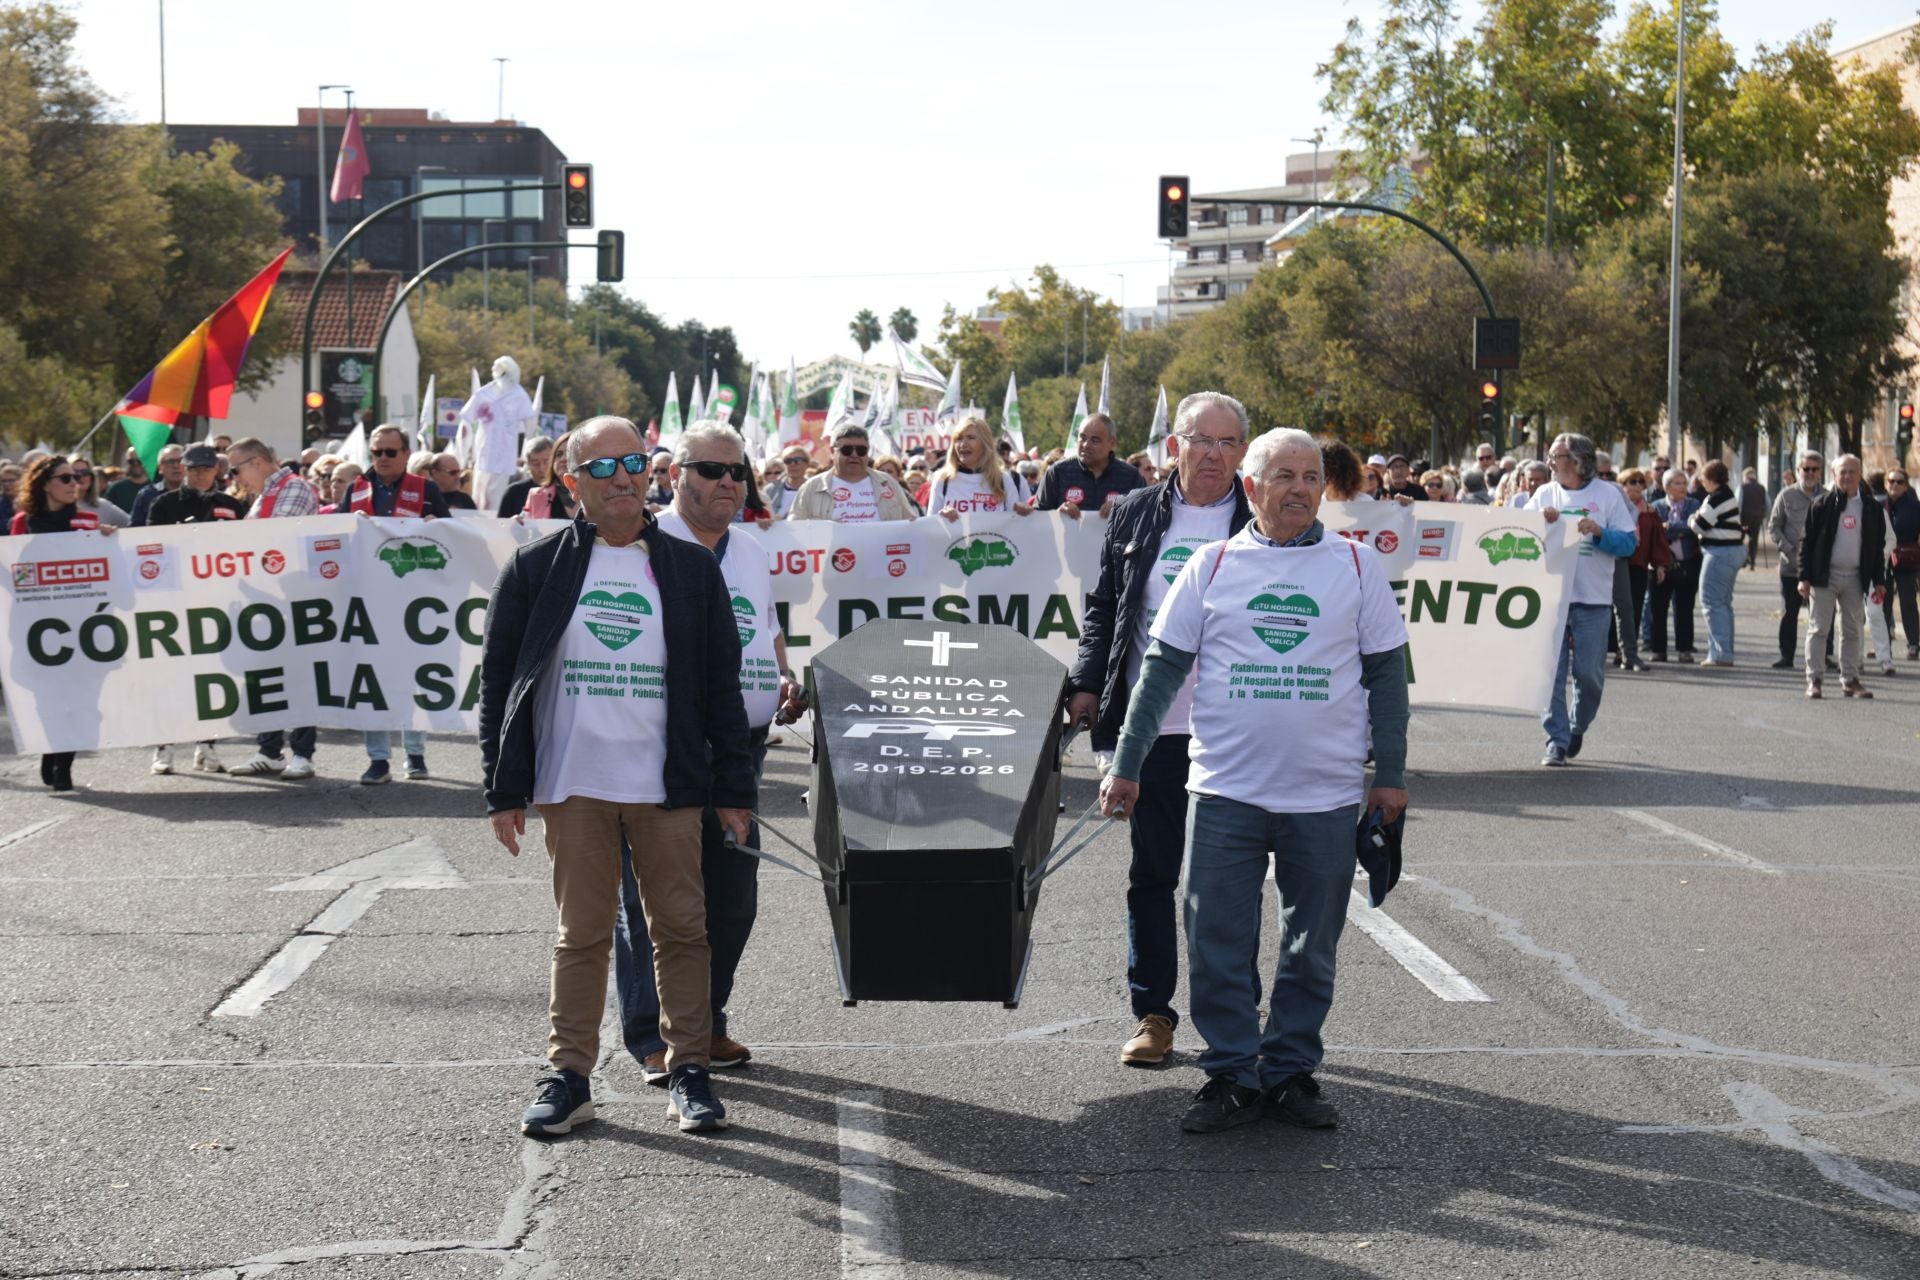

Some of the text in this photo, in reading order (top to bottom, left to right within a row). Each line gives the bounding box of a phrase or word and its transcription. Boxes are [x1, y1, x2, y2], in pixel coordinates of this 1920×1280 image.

[1067, 489, 1082, 497] UGT
[41, 562, 105, 581] CCOO
[191, 551, 254, 579] UGT
[600, 581, 632, 589] DEFIENDE
[1267, 583, 1300, 591] DEFIENDE
[602, 600, 645, 613] HOSPITAL!!
[1270, 604, 1313, 615] HOSPITAL!!
[27, 597, 379, 666] CÓRDOBA
[596, 624, 631, 636] SANIDAD
[1264, 629, 1298, 640] SANIDAD
[563, 659, 665, 675] Plataforma en Defensa
[1230, 663, 1332, 676] Plataforma en Defensa
[577, 672, 615, 685] Hospital
[616, 674, 629, 686] de
[630, 675, 665, 688] Montilla
[869, 674, 1008, 689] SANIDAD
[1230, 676, 1243, 686] del
[1243, 676, 1282, 687] Hospital
[1283, 677, 1295, 687] de
[195, 666, 290, 721] DE
[313, 661, 389, 711] LA
[587, 685, 625, 698] Sanidad
[632, 688, 665, 700] Pública
[1237, 688, 1246, 699] la
[1252, 689, 1292, 700] Sanidad
[1299, 690, 1329, 701] Pública
[843, 703, 1025, 718] ANDALUZA
[853, 762, 1015, 775] 2019-2026
